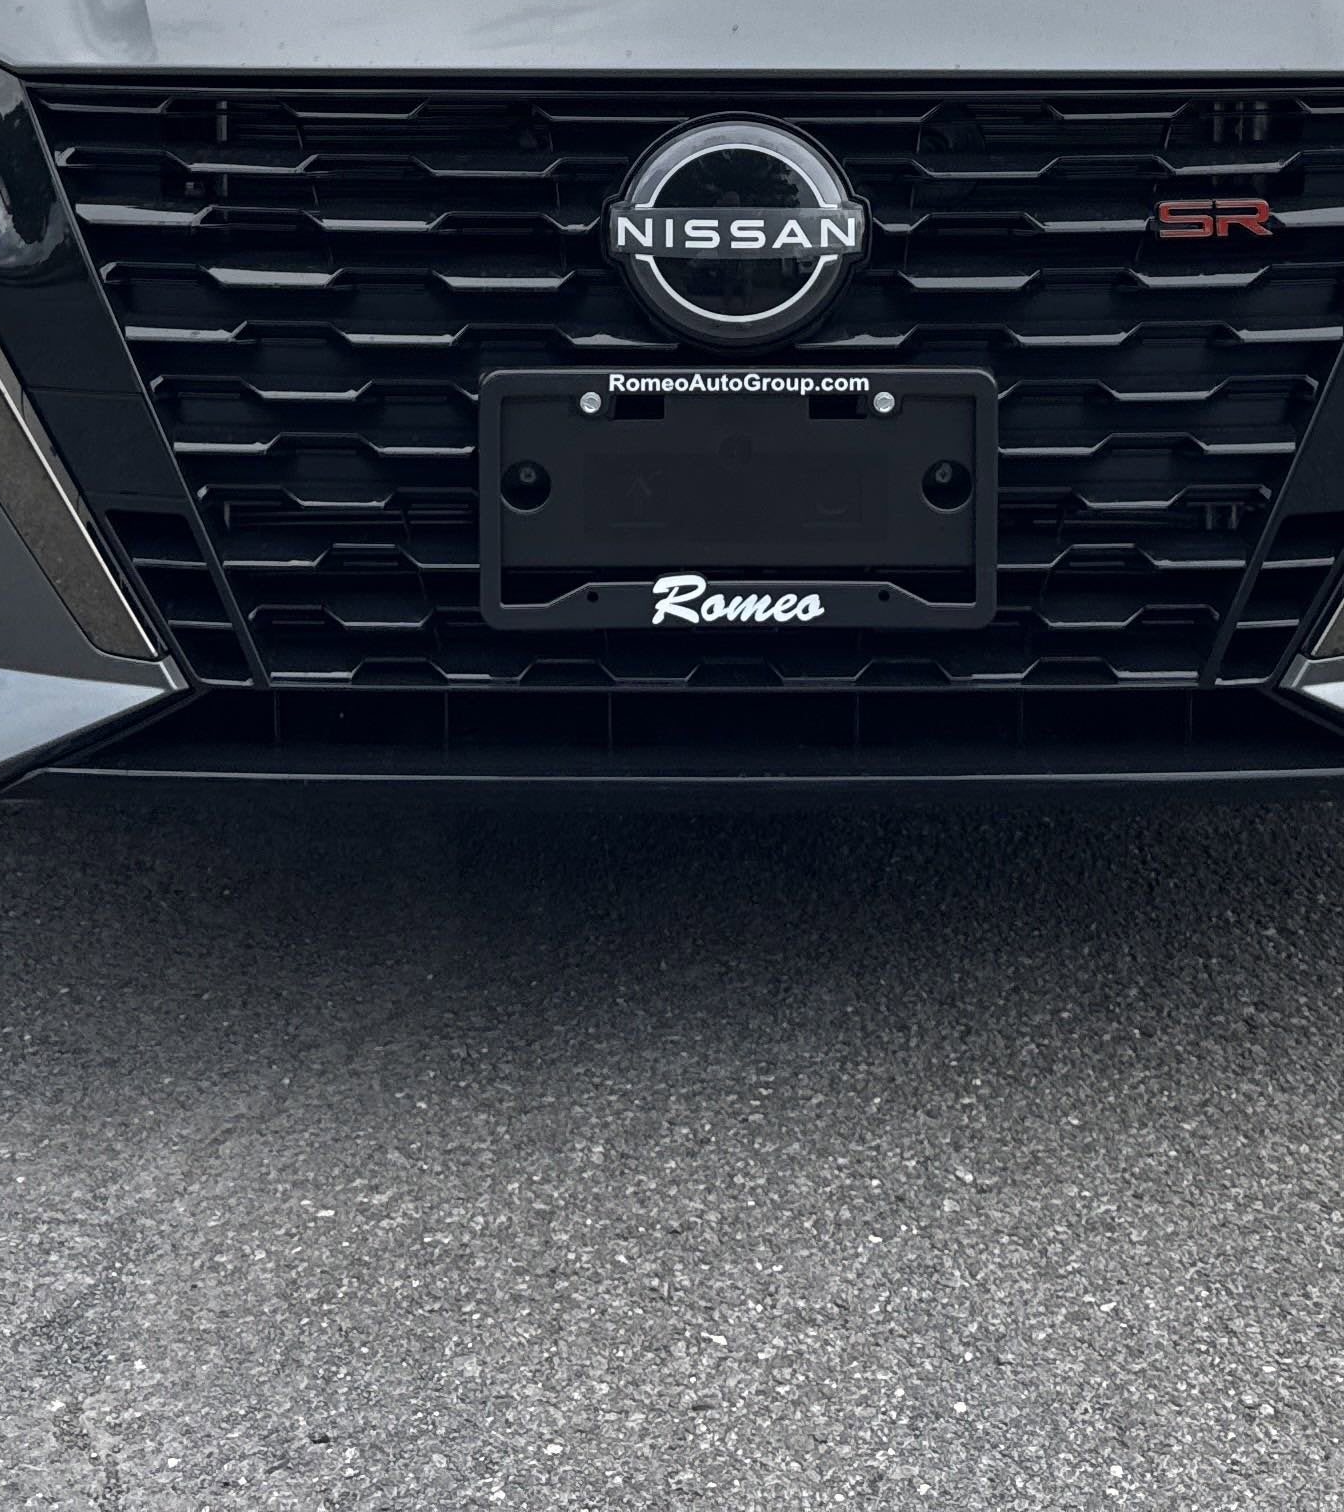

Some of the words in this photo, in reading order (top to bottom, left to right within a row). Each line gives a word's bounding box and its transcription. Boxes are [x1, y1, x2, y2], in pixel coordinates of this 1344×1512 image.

[617, 217, 856, 249] NISSAN
[1158, 198, 1274, 238] SR
[608, 373, 870, 396] RomeoAutoGroup.com
[652, 574, 825, 625] Romeo
